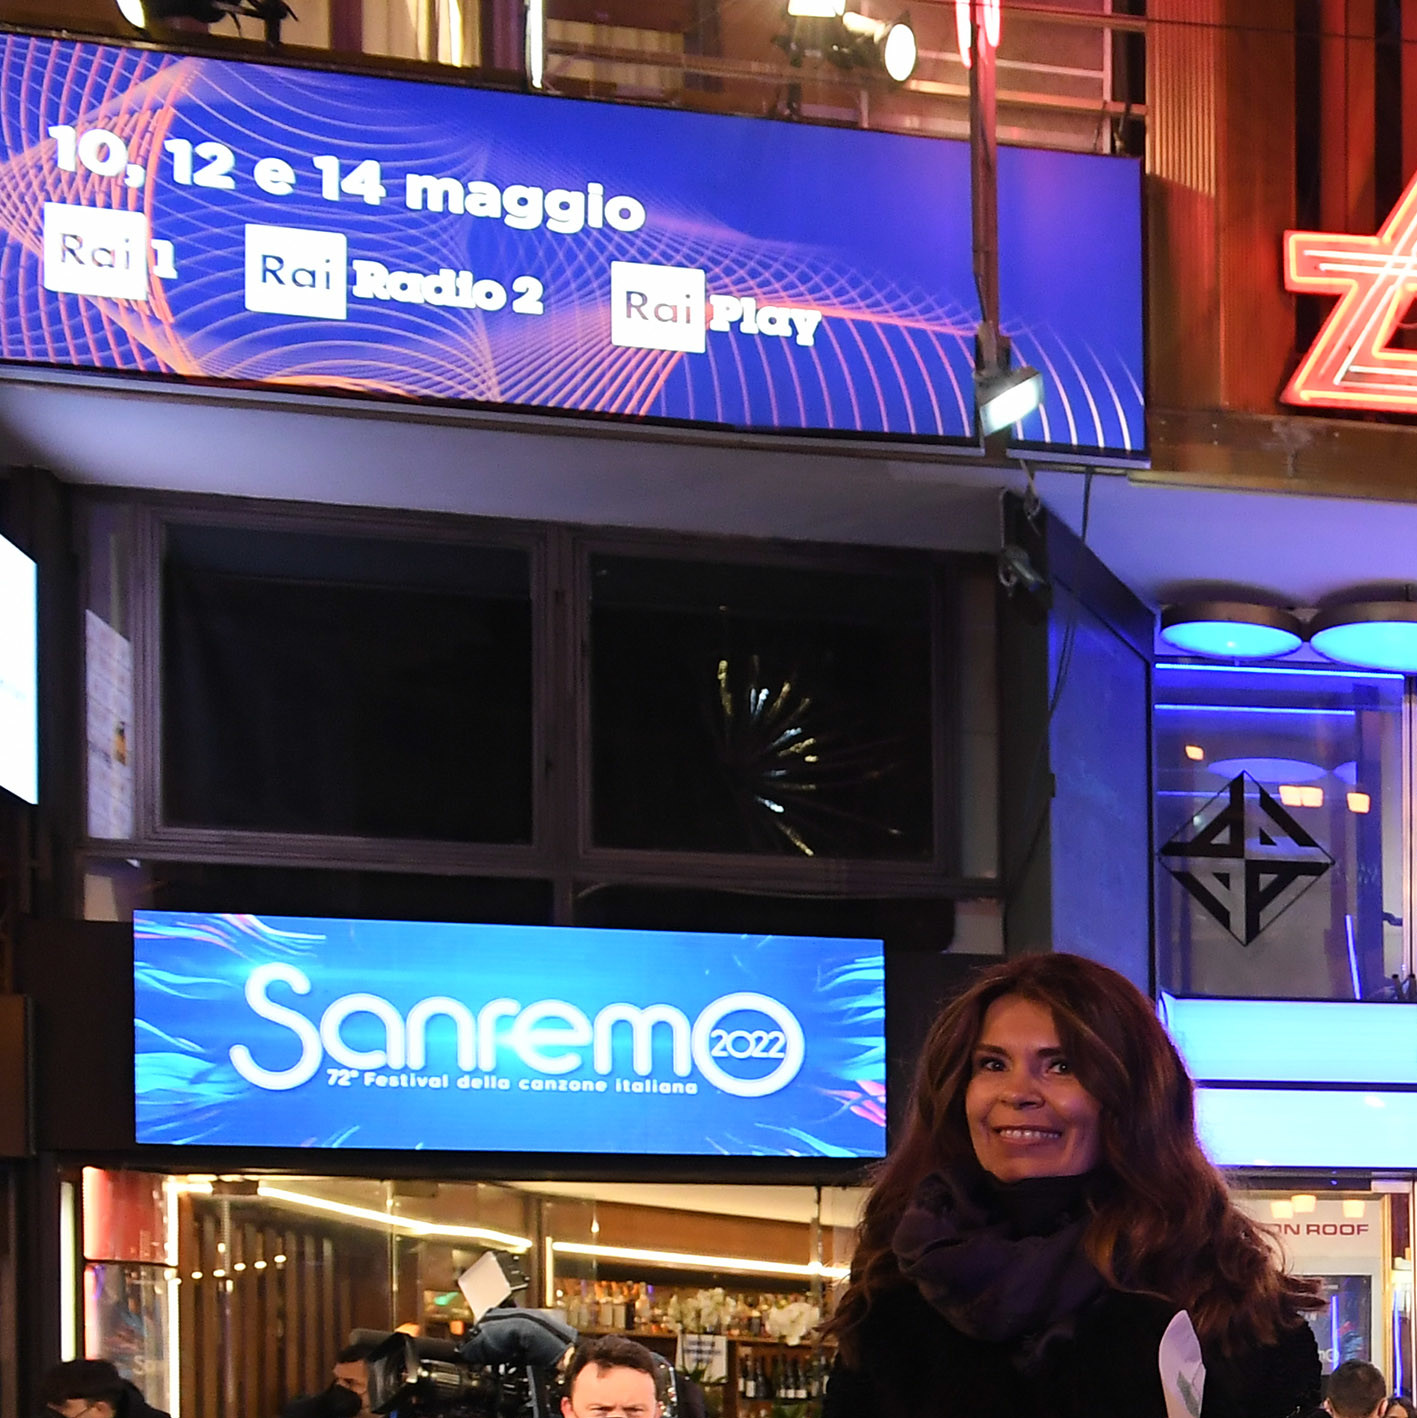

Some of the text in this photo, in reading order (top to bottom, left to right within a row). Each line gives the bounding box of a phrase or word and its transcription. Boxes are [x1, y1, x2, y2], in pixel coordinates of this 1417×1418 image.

[48, 125, 646, 234] 10, 12 e 14 maggio
[60, 232, 130, 269] Rai
[261, 254, 543, 315] Rai Radio 2
[626, 290, 822, 346] Rai Play
[229, 962, 804, 1097] Sanremo
[709, 1028, 786, 1060] 2022
[326, 1068, 698, 1095] 72° Festival della canzone italiana
[1306, 1223, 1369, 1235] ROOF
